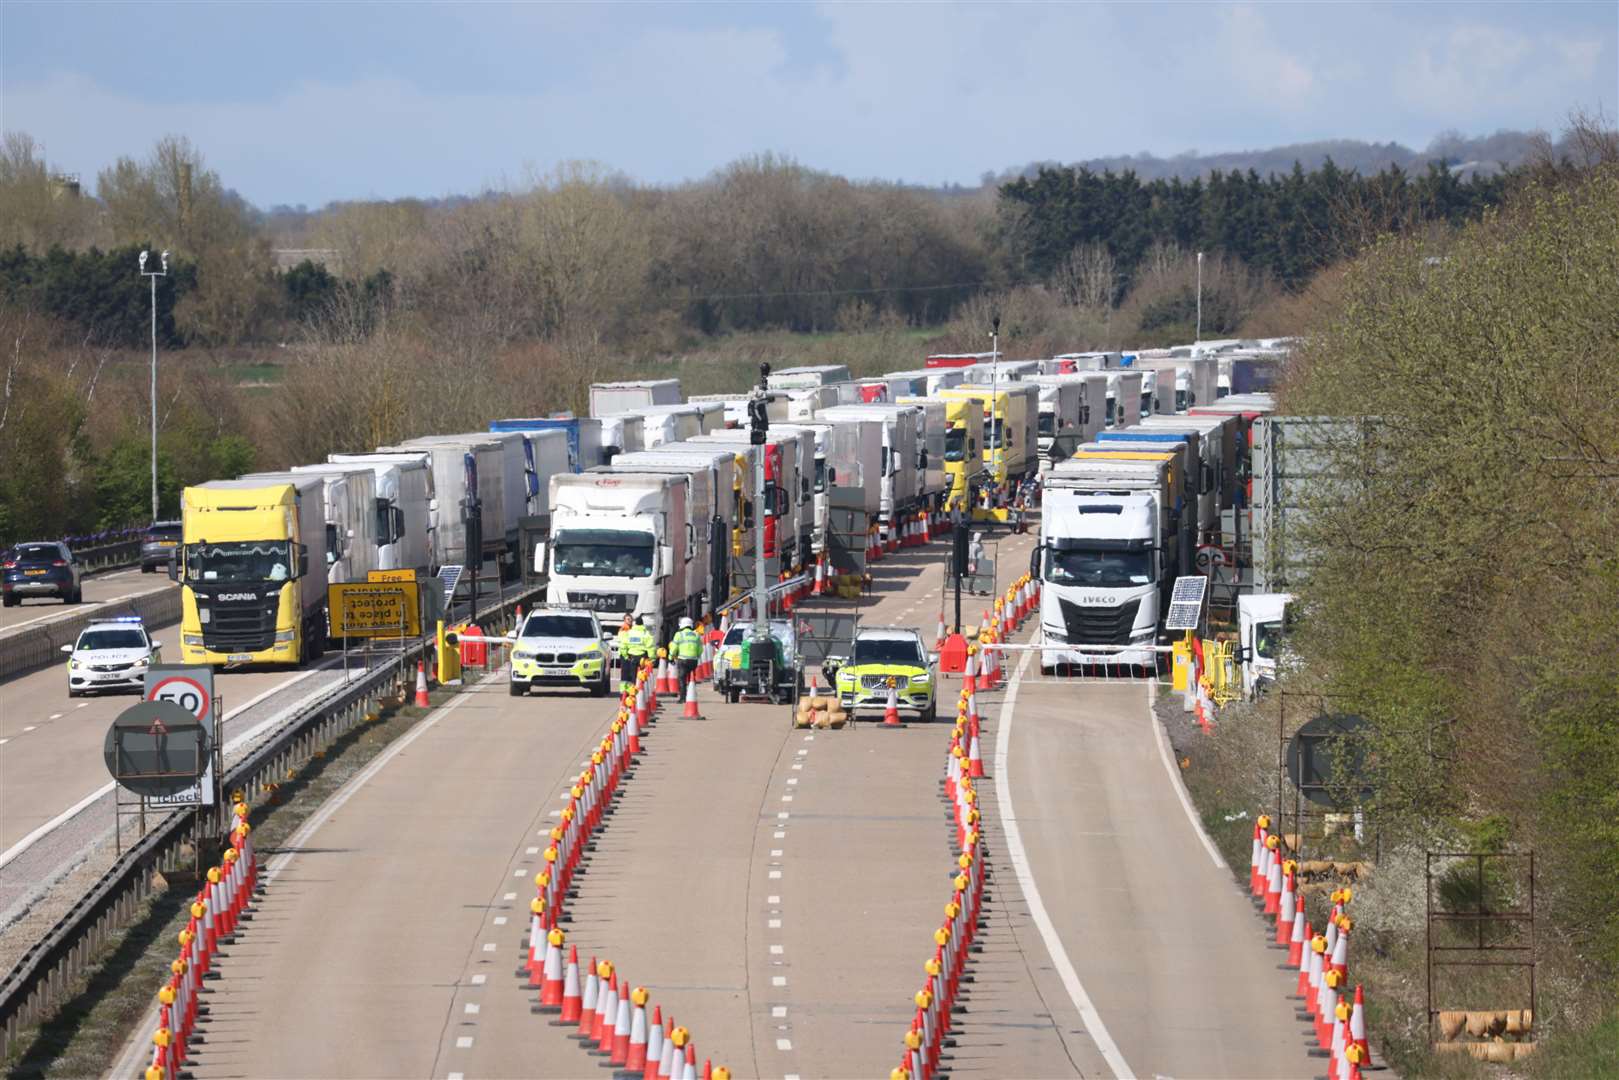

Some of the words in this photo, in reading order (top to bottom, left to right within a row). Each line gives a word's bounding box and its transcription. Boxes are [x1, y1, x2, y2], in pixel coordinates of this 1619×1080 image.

[217, 593, 257, 602] SCANIA
[1083, 595, 1116, 604] IVECO
[351, 599, 396, 609] protect
[359, 609, 391, 620] place
